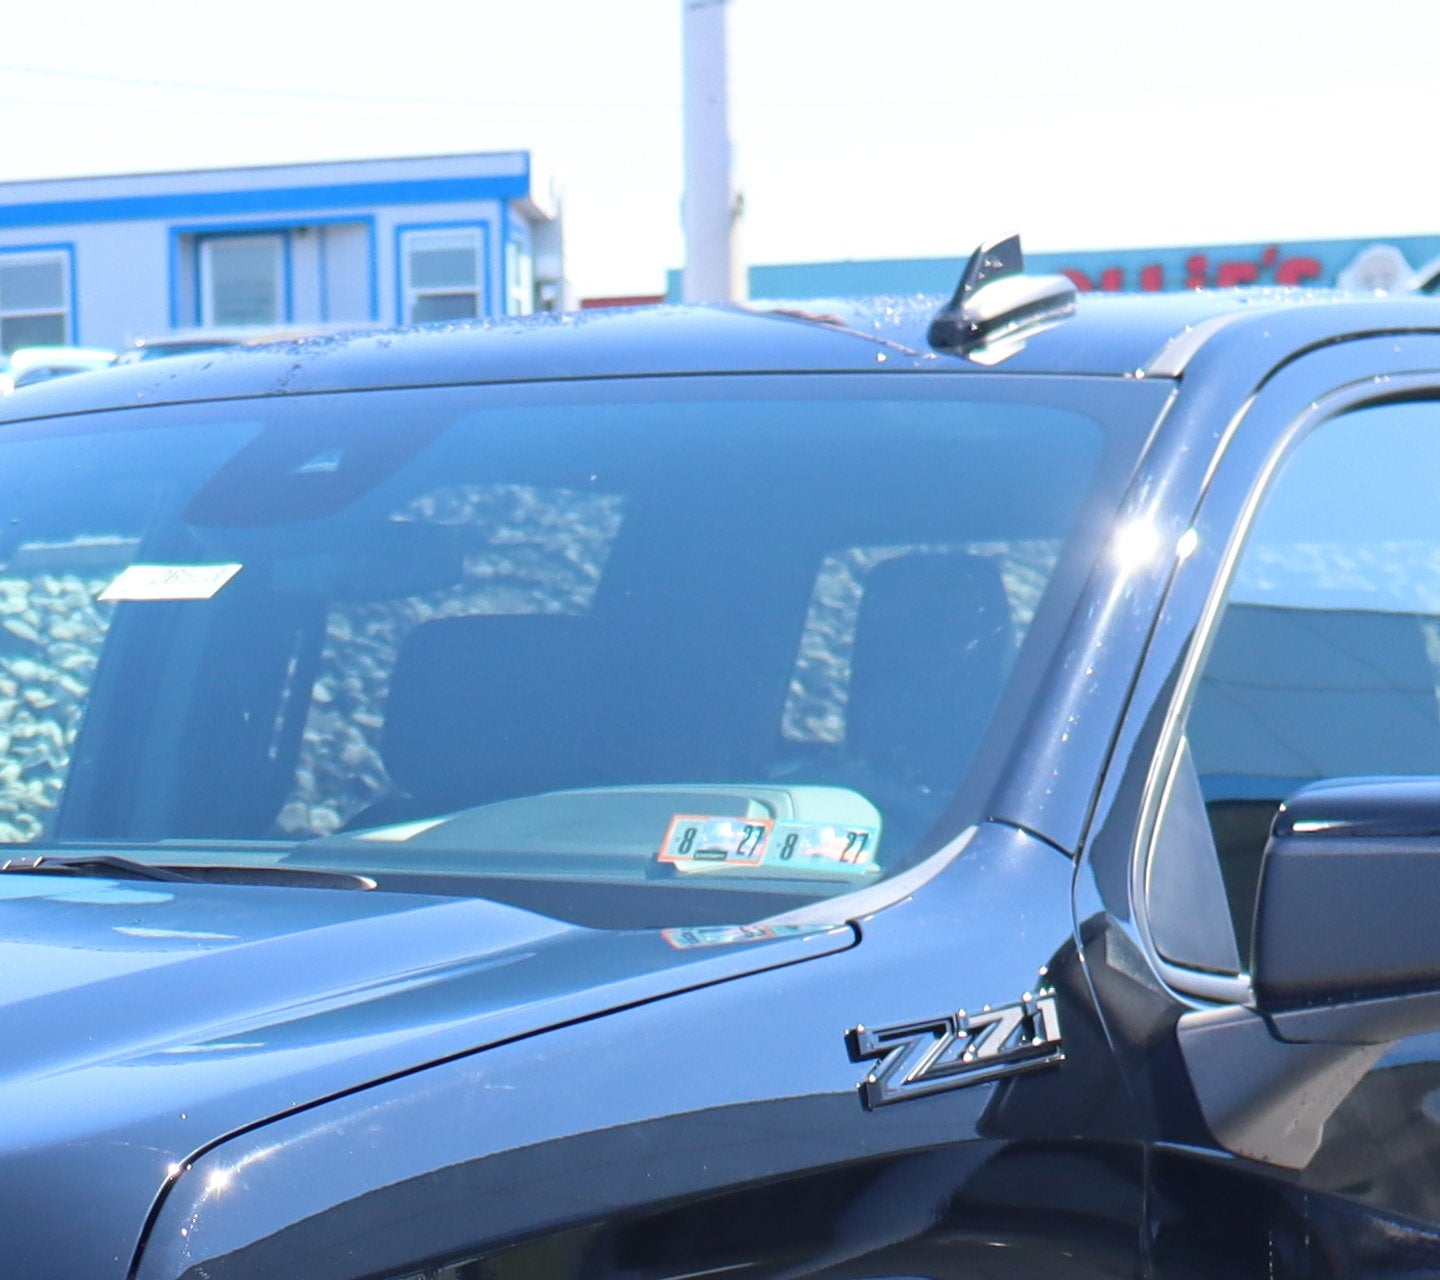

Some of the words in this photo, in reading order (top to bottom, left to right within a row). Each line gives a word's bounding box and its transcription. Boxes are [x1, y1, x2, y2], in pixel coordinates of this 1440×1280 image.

[678, 827, 697, 855] 8
[736, 824, 766, 858] 27
[779, 833, 799, 861] 8
[839, 831, 870, 864] 27
[844, 990, 1066, 1111] Z71
